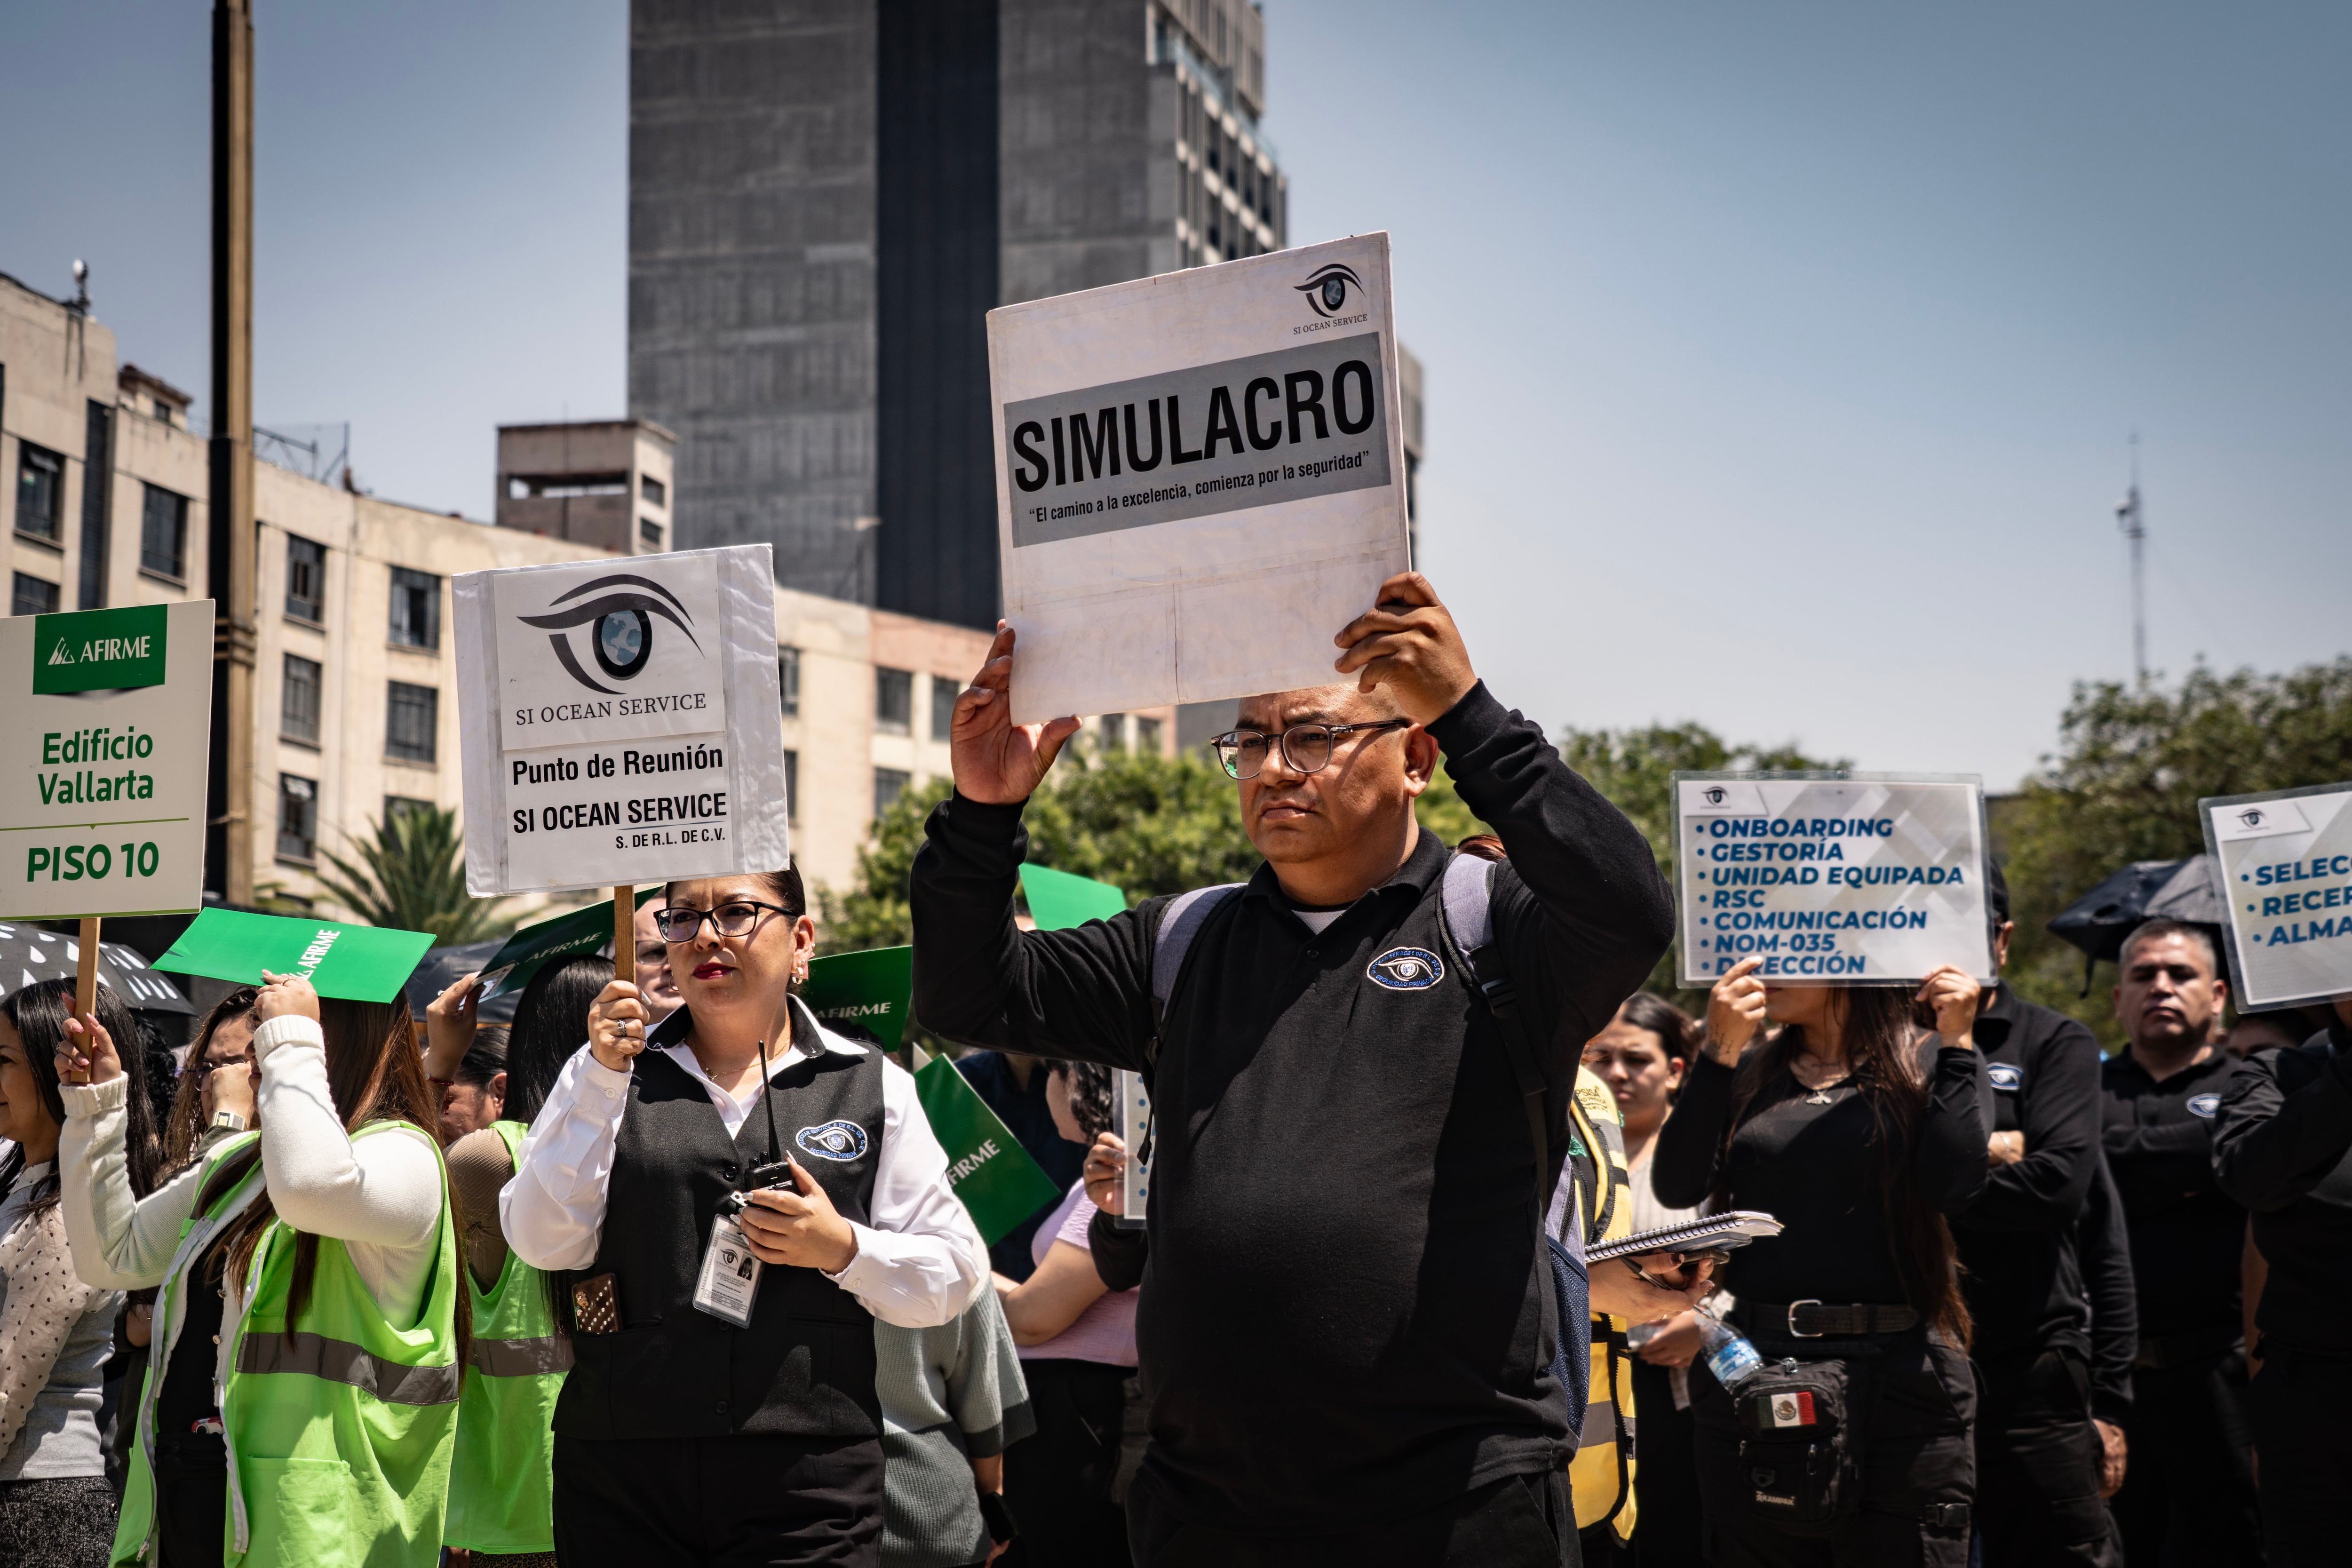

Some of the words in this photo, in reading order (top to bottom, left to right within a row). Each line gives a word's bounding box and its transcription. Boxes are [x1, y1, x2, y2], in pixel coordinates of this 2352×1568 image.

[1303, 321, 1330, 333] OCEAN
[1333, 314, 1367, 328] SERVICE
[1013, 360, 1374, 493] SIMULACRO
[1051, 501, 1092, 519] camino
[1097, 501, 1103, 512] a
[1107, 496, 1118, 509] la
[1122, 484, 1191, 507] excelencia,
[1196, 474, 1254, 494] comienza
[1259, 470, 1279, 487] por
[1283, 465, 1294, 479] la
[80, 636, 150, 662] AFIRME
[516, 709, 534, 725] SI
[541, 702, 611, 722] OCEAN
[620, 693, 706, 716] SERVICE
[43, 726, 152, 764] Edificio
[513, 758, 578, 785] Punto
[588, 754, 614, 778] de
[624, 744, 723, 775] Reunión
[38, 770, 153, 804] Vallarta
[514, 809, 534, 833] SI
[543, 802, 620, 830] OCEAN
[628, 793, 726, 824] SERVICE
[616, 836, 628, 849] S.
[633, 834, 648, 847] DE
[652, 833, 676, 845] R.L.
[682, 830, 697, 843] DE
[702, 828, 725, 842] C.V.
[1710, 819, 1892, 838] ONBOARDING
[27, 844, 111, 882] PISO
[121, 842, 159, 877] 10
[1711, 838, 1843, 862] GESTORÍA
[1713, 867, 1818, 886] UNIDAD
[1828, 867, 1963, 889] EQUIPADA
[2256, 855, 2352, 886] SELEC
[1713, 890, 1765, 908] RSC
[1714, 906, 1926, 931] COMUNICACIÓN
[297, 929, 341, 969] AFIRME
[524, 931, 603, 963] AFIRME
[1715, 934, 1835, 953] NOM-035
[1715, 951, 1866, 976] DECCIÓN
[1375, 974, 1407, 987] SEGURIDAD
[1409, 976, 1434, 987] PRIVADA
[816, 1002, 892, 1018] AFIRME
[811, 1124, 832, 1134] SERVICE
[856, 1130, 863, 1138] DE
[809, 1147, 837, 1158] SEGURIDAD
[946, 1139, 1001, 1187] FIRME
